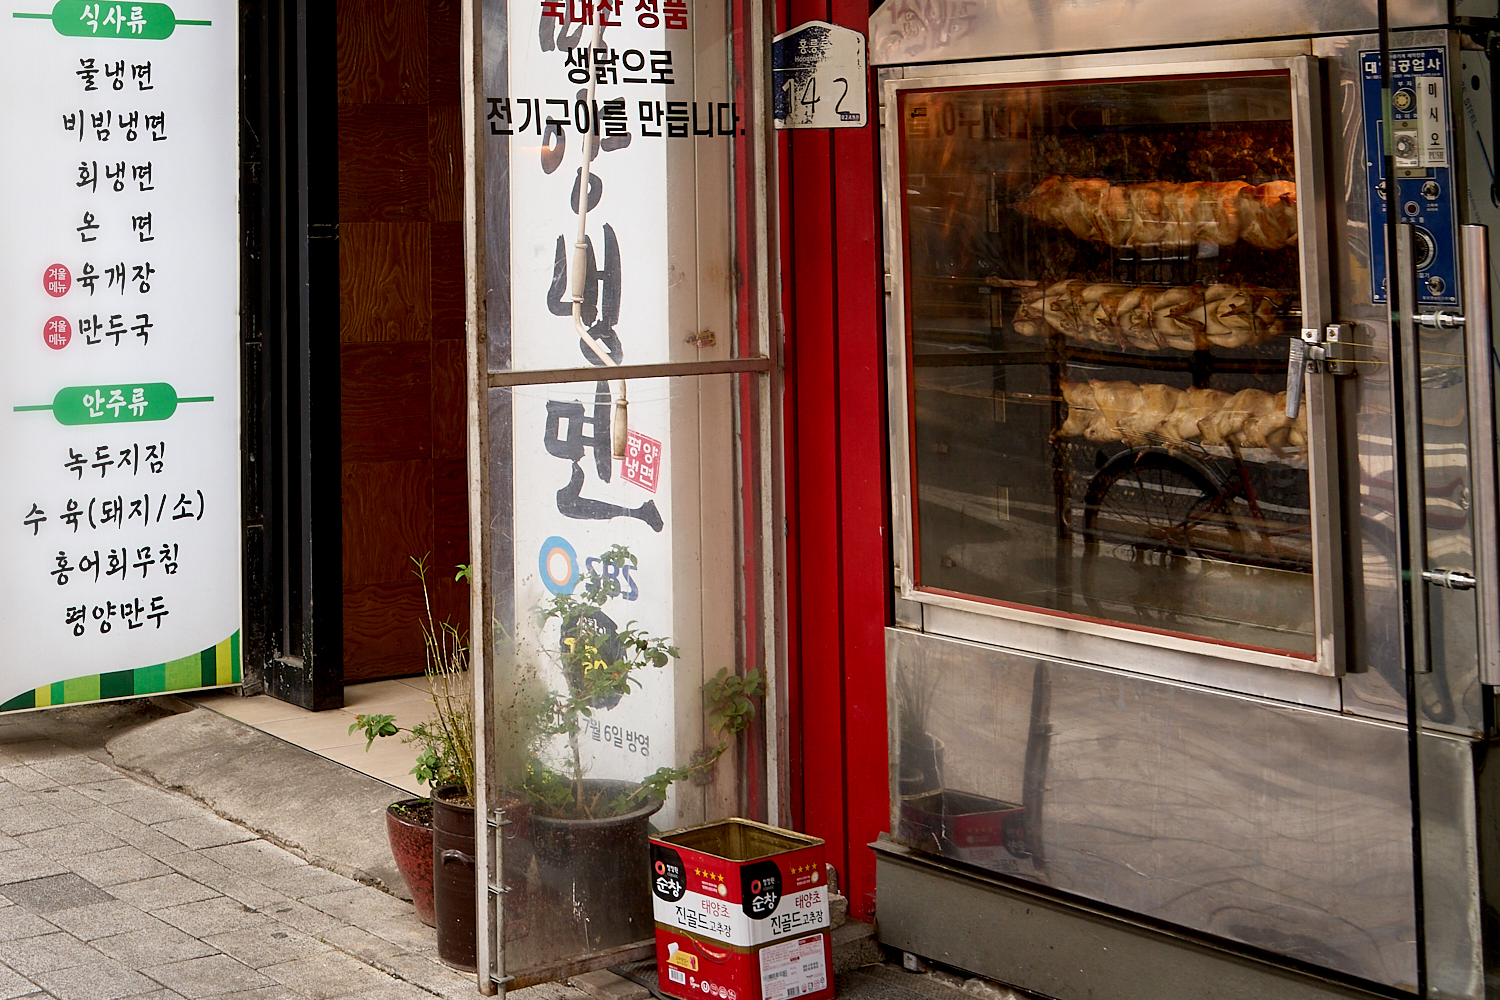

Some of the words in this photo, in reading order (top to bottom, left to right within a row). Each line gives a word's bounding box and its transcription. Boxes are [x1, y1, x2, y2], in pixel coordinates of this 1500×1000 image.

[78, 4, 148, 34] 식사류
[76, 58, 155, 92] 물냉면
[563, 47, 675, 85] 생닭으로
[62, 109, 168, 143] 비빔냉면
[486, 97, 629, 138] 전기구이를
[638, 99, 746, 139] 만듭니다.
[1428, 82, 1441, 146] 미시오
[1428, 151, 1444, 162] PUSH
[75, 161, 155, 193] 회냉면
[48, 266, 67, 281] 겨울
[48, 280, 67, 293] 메뉴
[76, 262, 156, 295] 육개장
[48, 319, 67, 334] 겨울
[48, 332, 67, 346] 메뉴
[77, 313, 154, 347] 만두국
[82, 388, 149, 418] 안주류
[63, 441, 167, 480] 녹두지짐
[626, 433, 660, 465] 평양
[623, 456, 656, 488] 냉면
[50, 543, 180, 586] 홍어회무침
[65, 595, 170, 637] 평양만두
[604, 723, 624, 749] 6일
[626, 727, 651, 759] 방영
[656, 876, 683, 898] 순창
[751, 891, 778, 913] 순창
[795, 889, 822, 909] 태양초
[701, 899, 731, 919] 태양초
